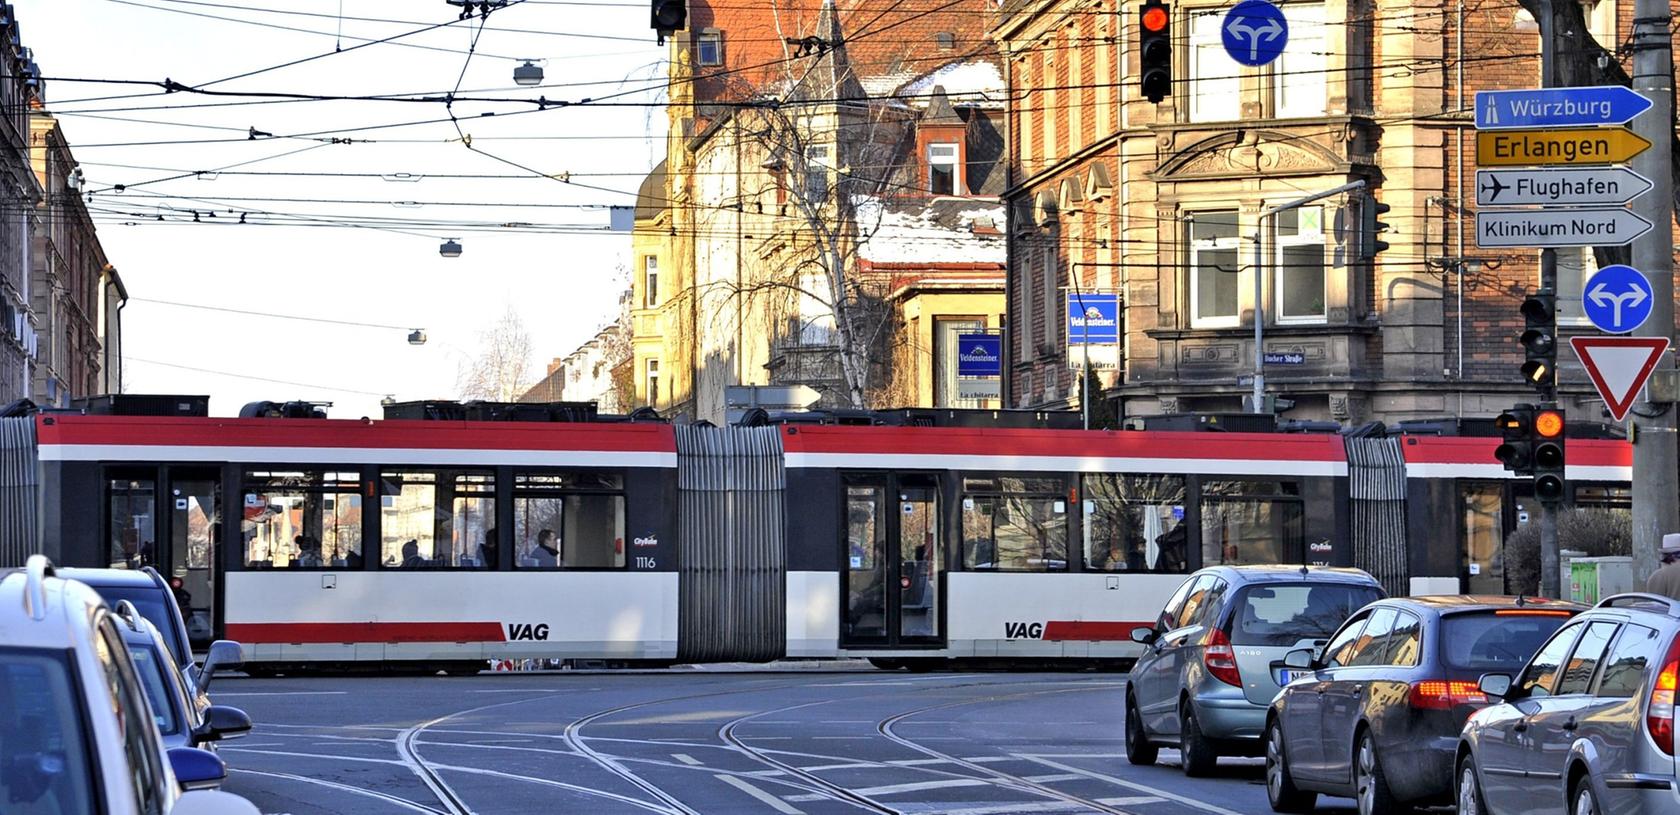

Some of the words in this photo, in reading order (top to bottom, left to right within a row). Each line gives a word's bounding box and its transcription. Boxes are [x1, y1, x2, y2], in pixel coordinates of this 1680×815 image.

[1510, 99, 1612, 119] Würzburg
[1495, 136, 1609, 161] Erlangen
[1517, 178, 1619, 200] Flughafen
[1485, 220, 1567, 237] Klinikum
[1571, 219, 1616, 235] Nord
[636, 556, 656, 568] 1116
[508, 623, 549, 640] VAG
[1005, 622, 1042, 639] VAG
